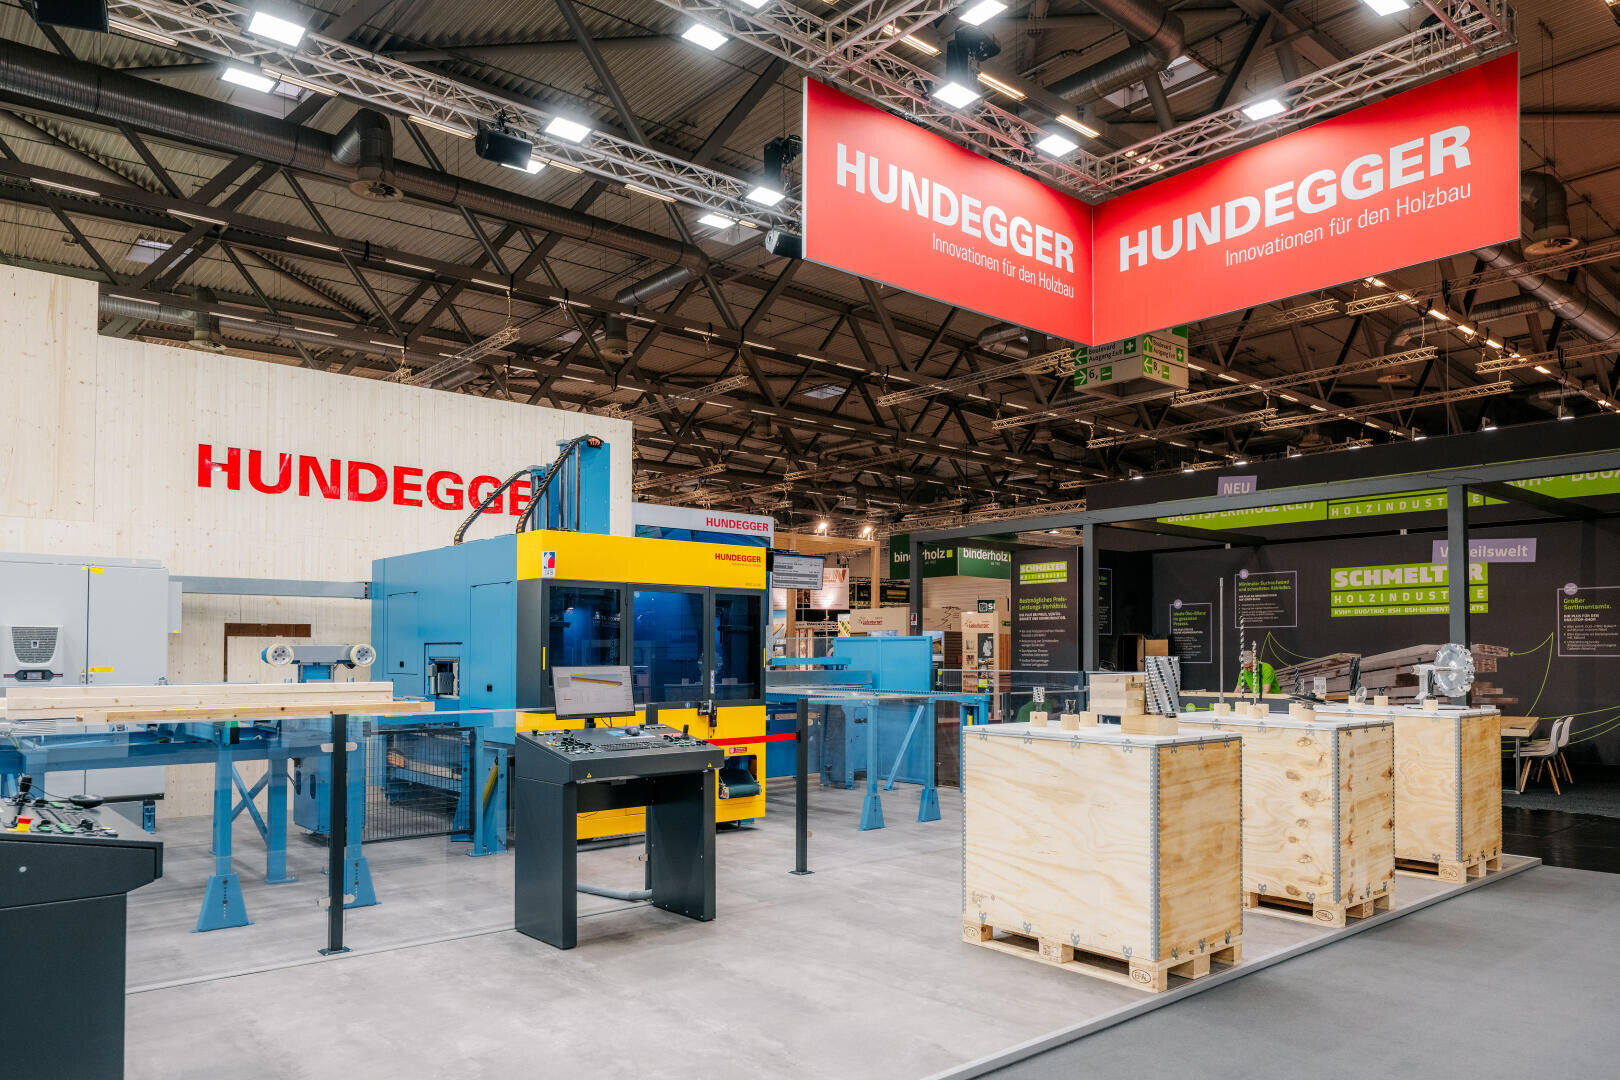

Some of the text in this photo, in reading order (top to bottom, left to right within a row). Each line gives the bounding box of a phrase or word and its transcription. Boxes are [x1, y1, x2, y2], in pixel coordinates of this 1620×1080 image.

[837, 142, 1074, 273] HUNDEGGER
[1120, 125, 1471, 272] HUNDEGGER
[1226, 182, 1471, 267] Innovationen für den Holzbau
[932, 232, 1074, 299] Innovationen für den Holzbau
[198, 443, 532, 517] HUNDEGGE
[1223, 482, 1250, 495] NEU
[1331, 494, 1480, 517] HOLZINDUSTE
[706, 517, 769, 532] HUNDEGGER
[714, 552, 761, 563] HUNDEGGER
[963, 547, 1009, 562] binderholz
[1440, 544, 1528, 559] Veilswelt
[1020, 562, 1066, 574] SCHMELTER
[1334, 563, 1483, 588] SCHMELTR
[1334, 588, 1485, 604] HOLZINDUSTE
